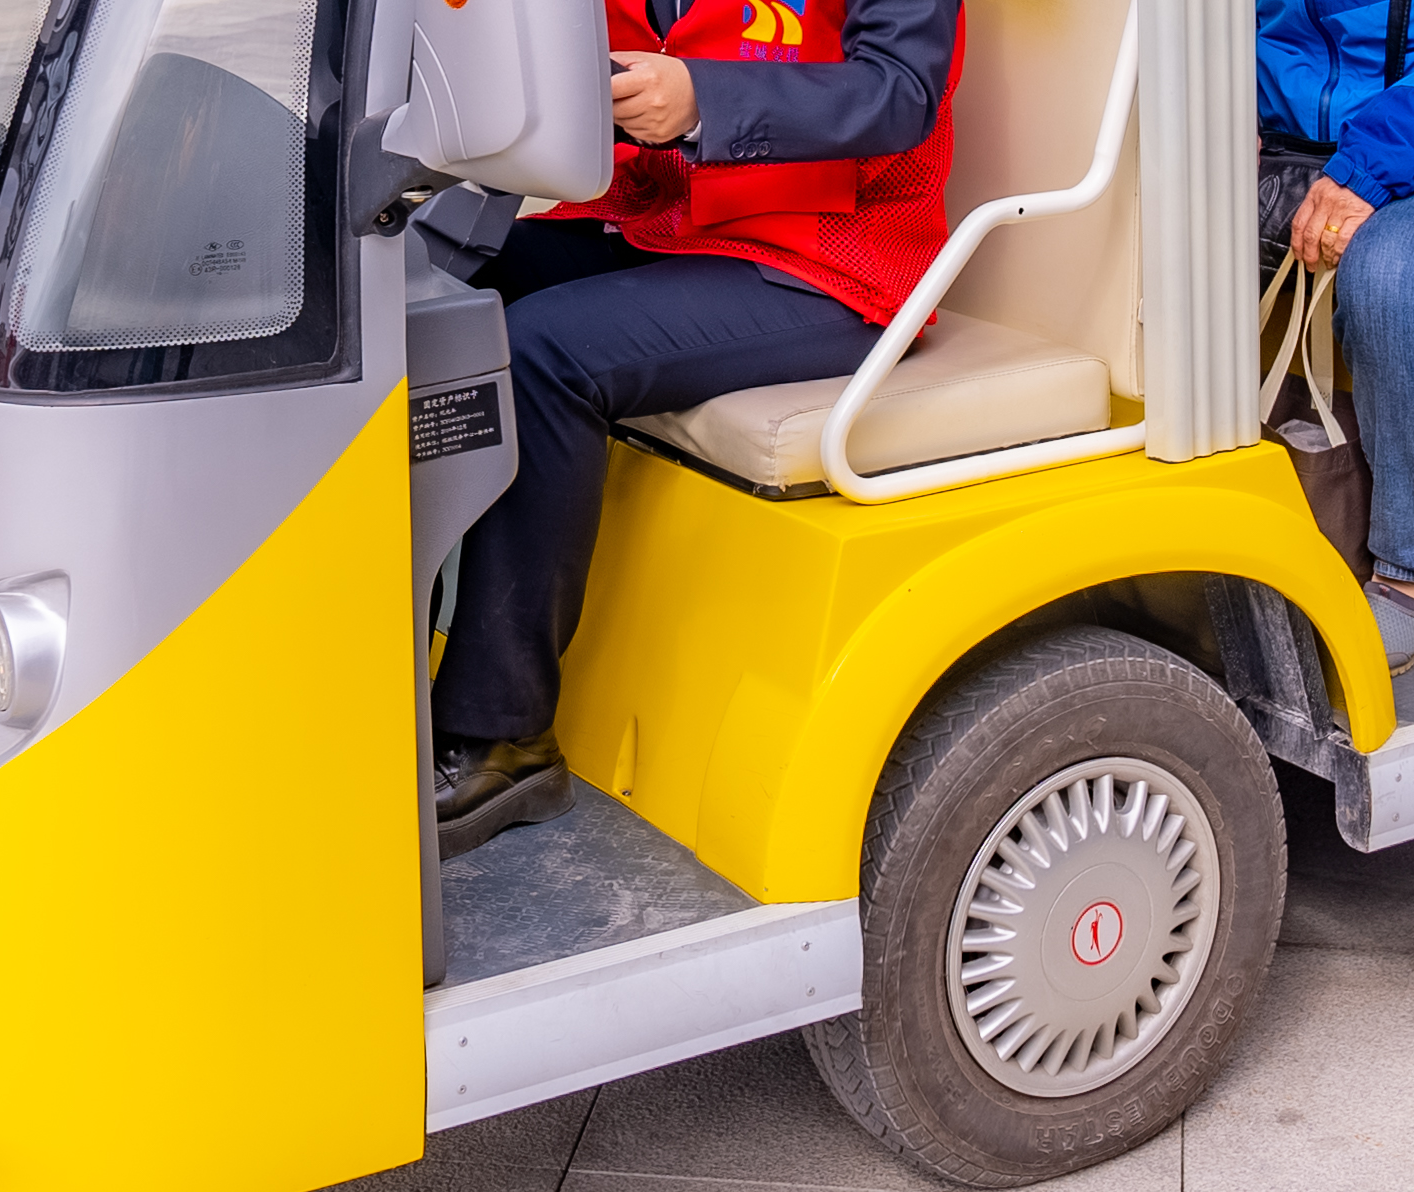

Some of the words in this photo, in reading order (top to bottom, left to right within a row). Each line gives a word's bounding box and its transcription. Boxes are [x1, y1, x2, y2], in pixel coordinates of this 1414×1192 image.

[423, 389, 479, 410] 固定资产标识卡
